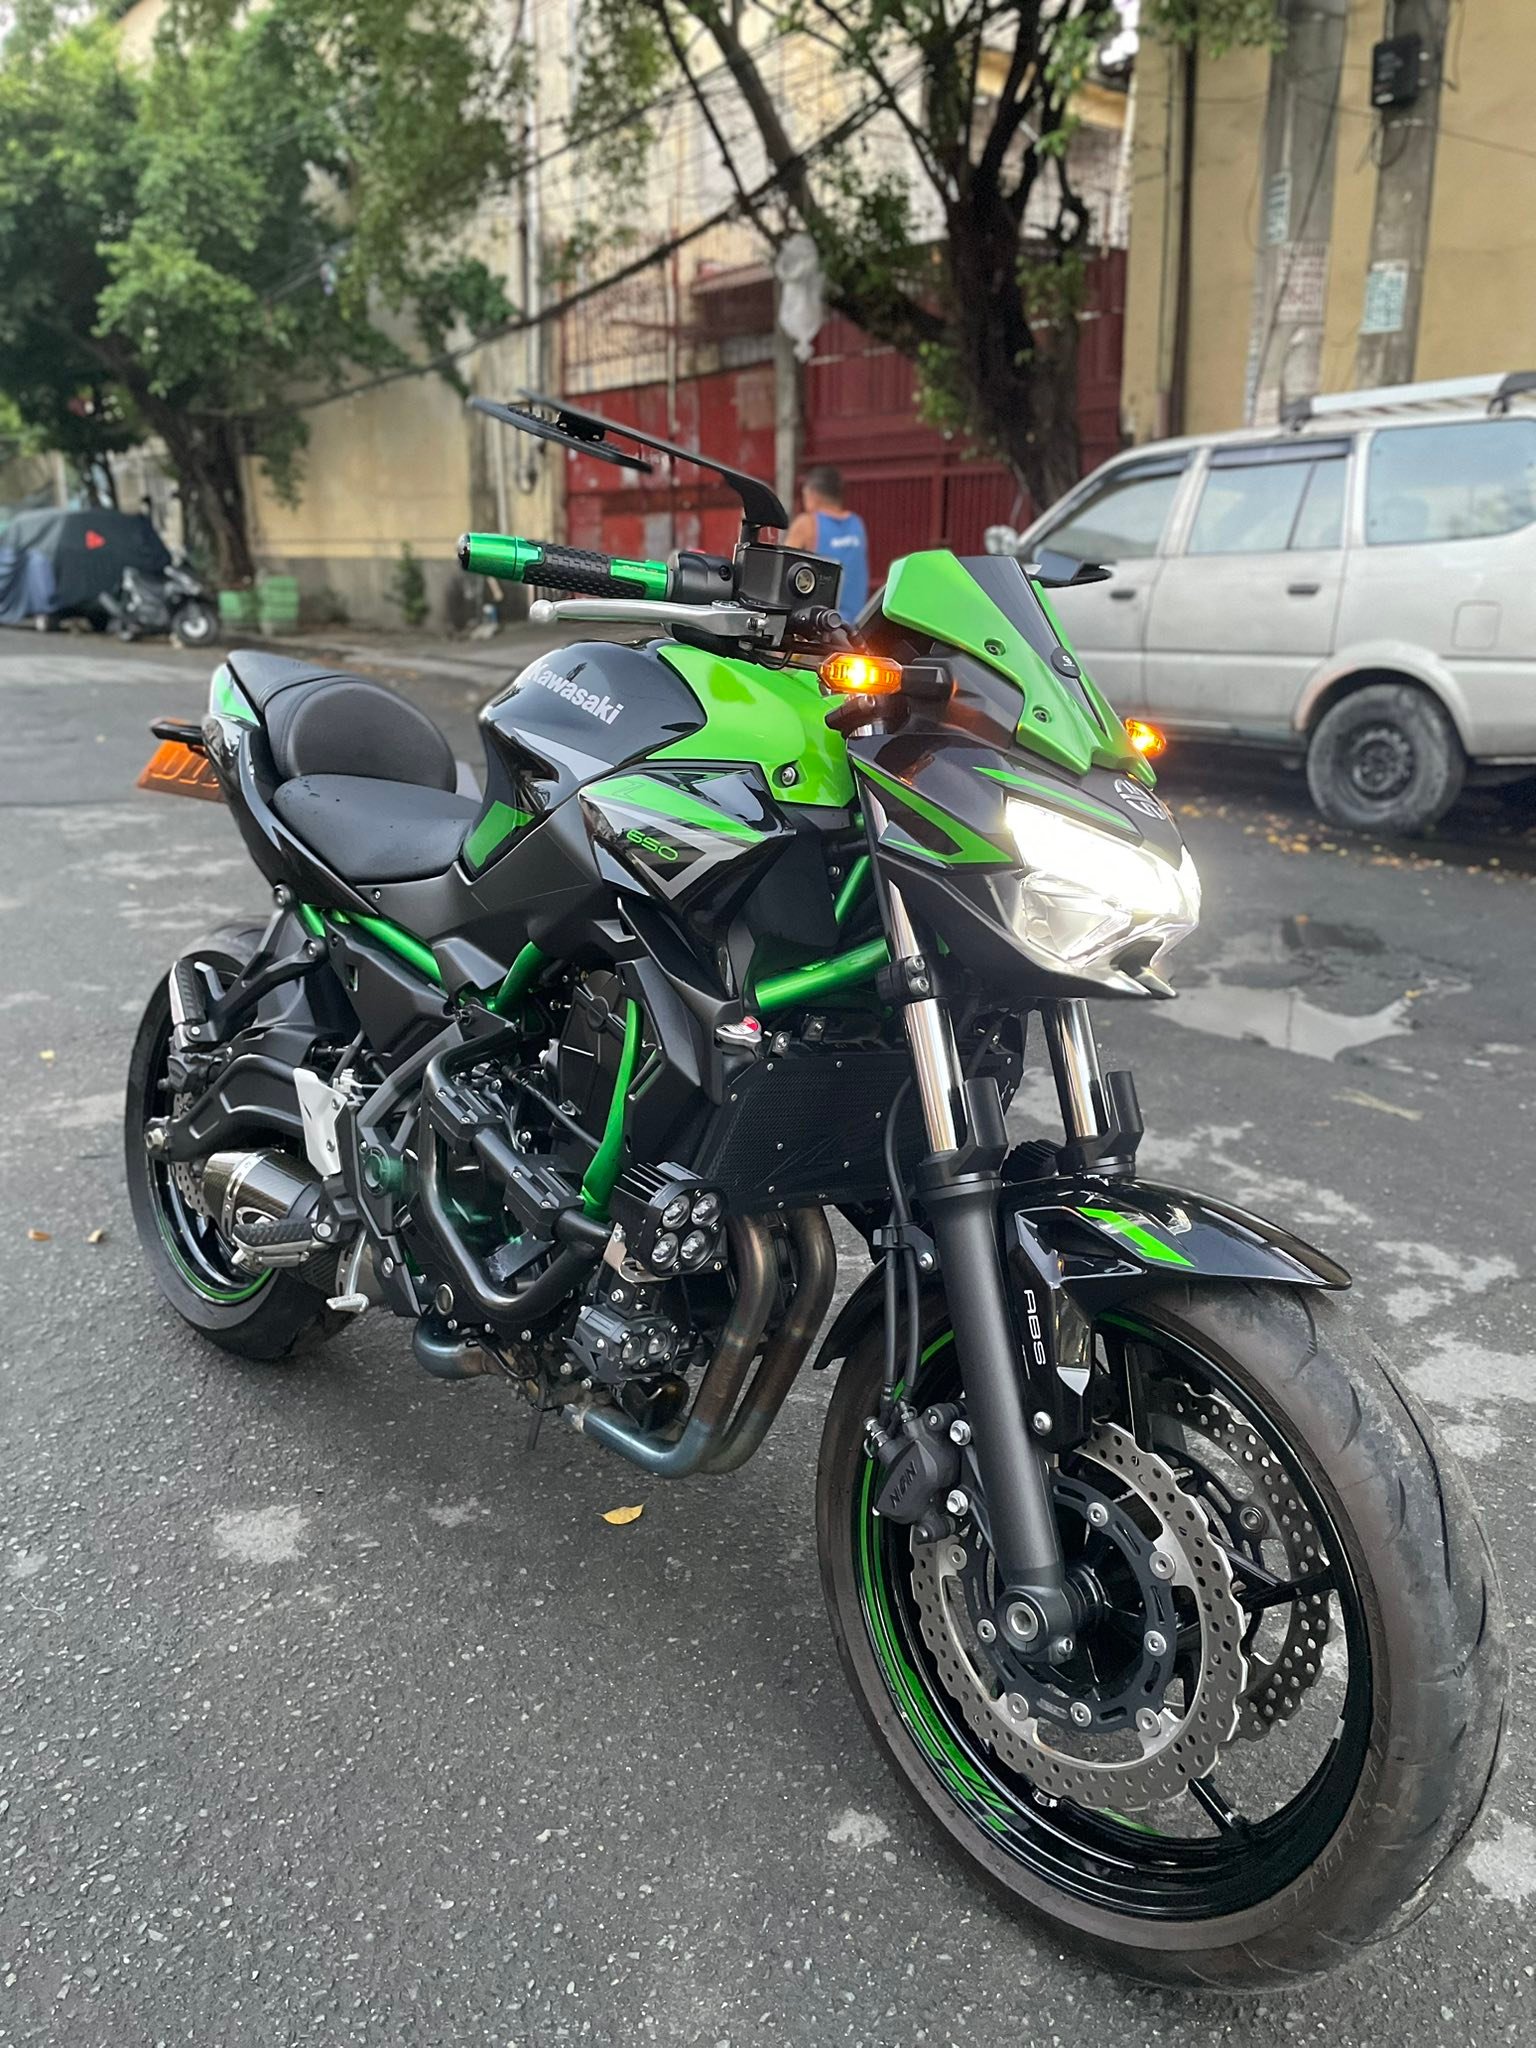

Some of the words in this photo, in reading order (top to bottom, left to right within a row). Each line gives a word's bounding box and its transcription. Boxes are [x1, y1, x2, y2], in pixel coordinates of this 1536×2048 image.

[527, 660, 624, 725] Kawasaki
[626, 829, 678, 861] 650
[1023, 1289, 1047, 1365] ABS
